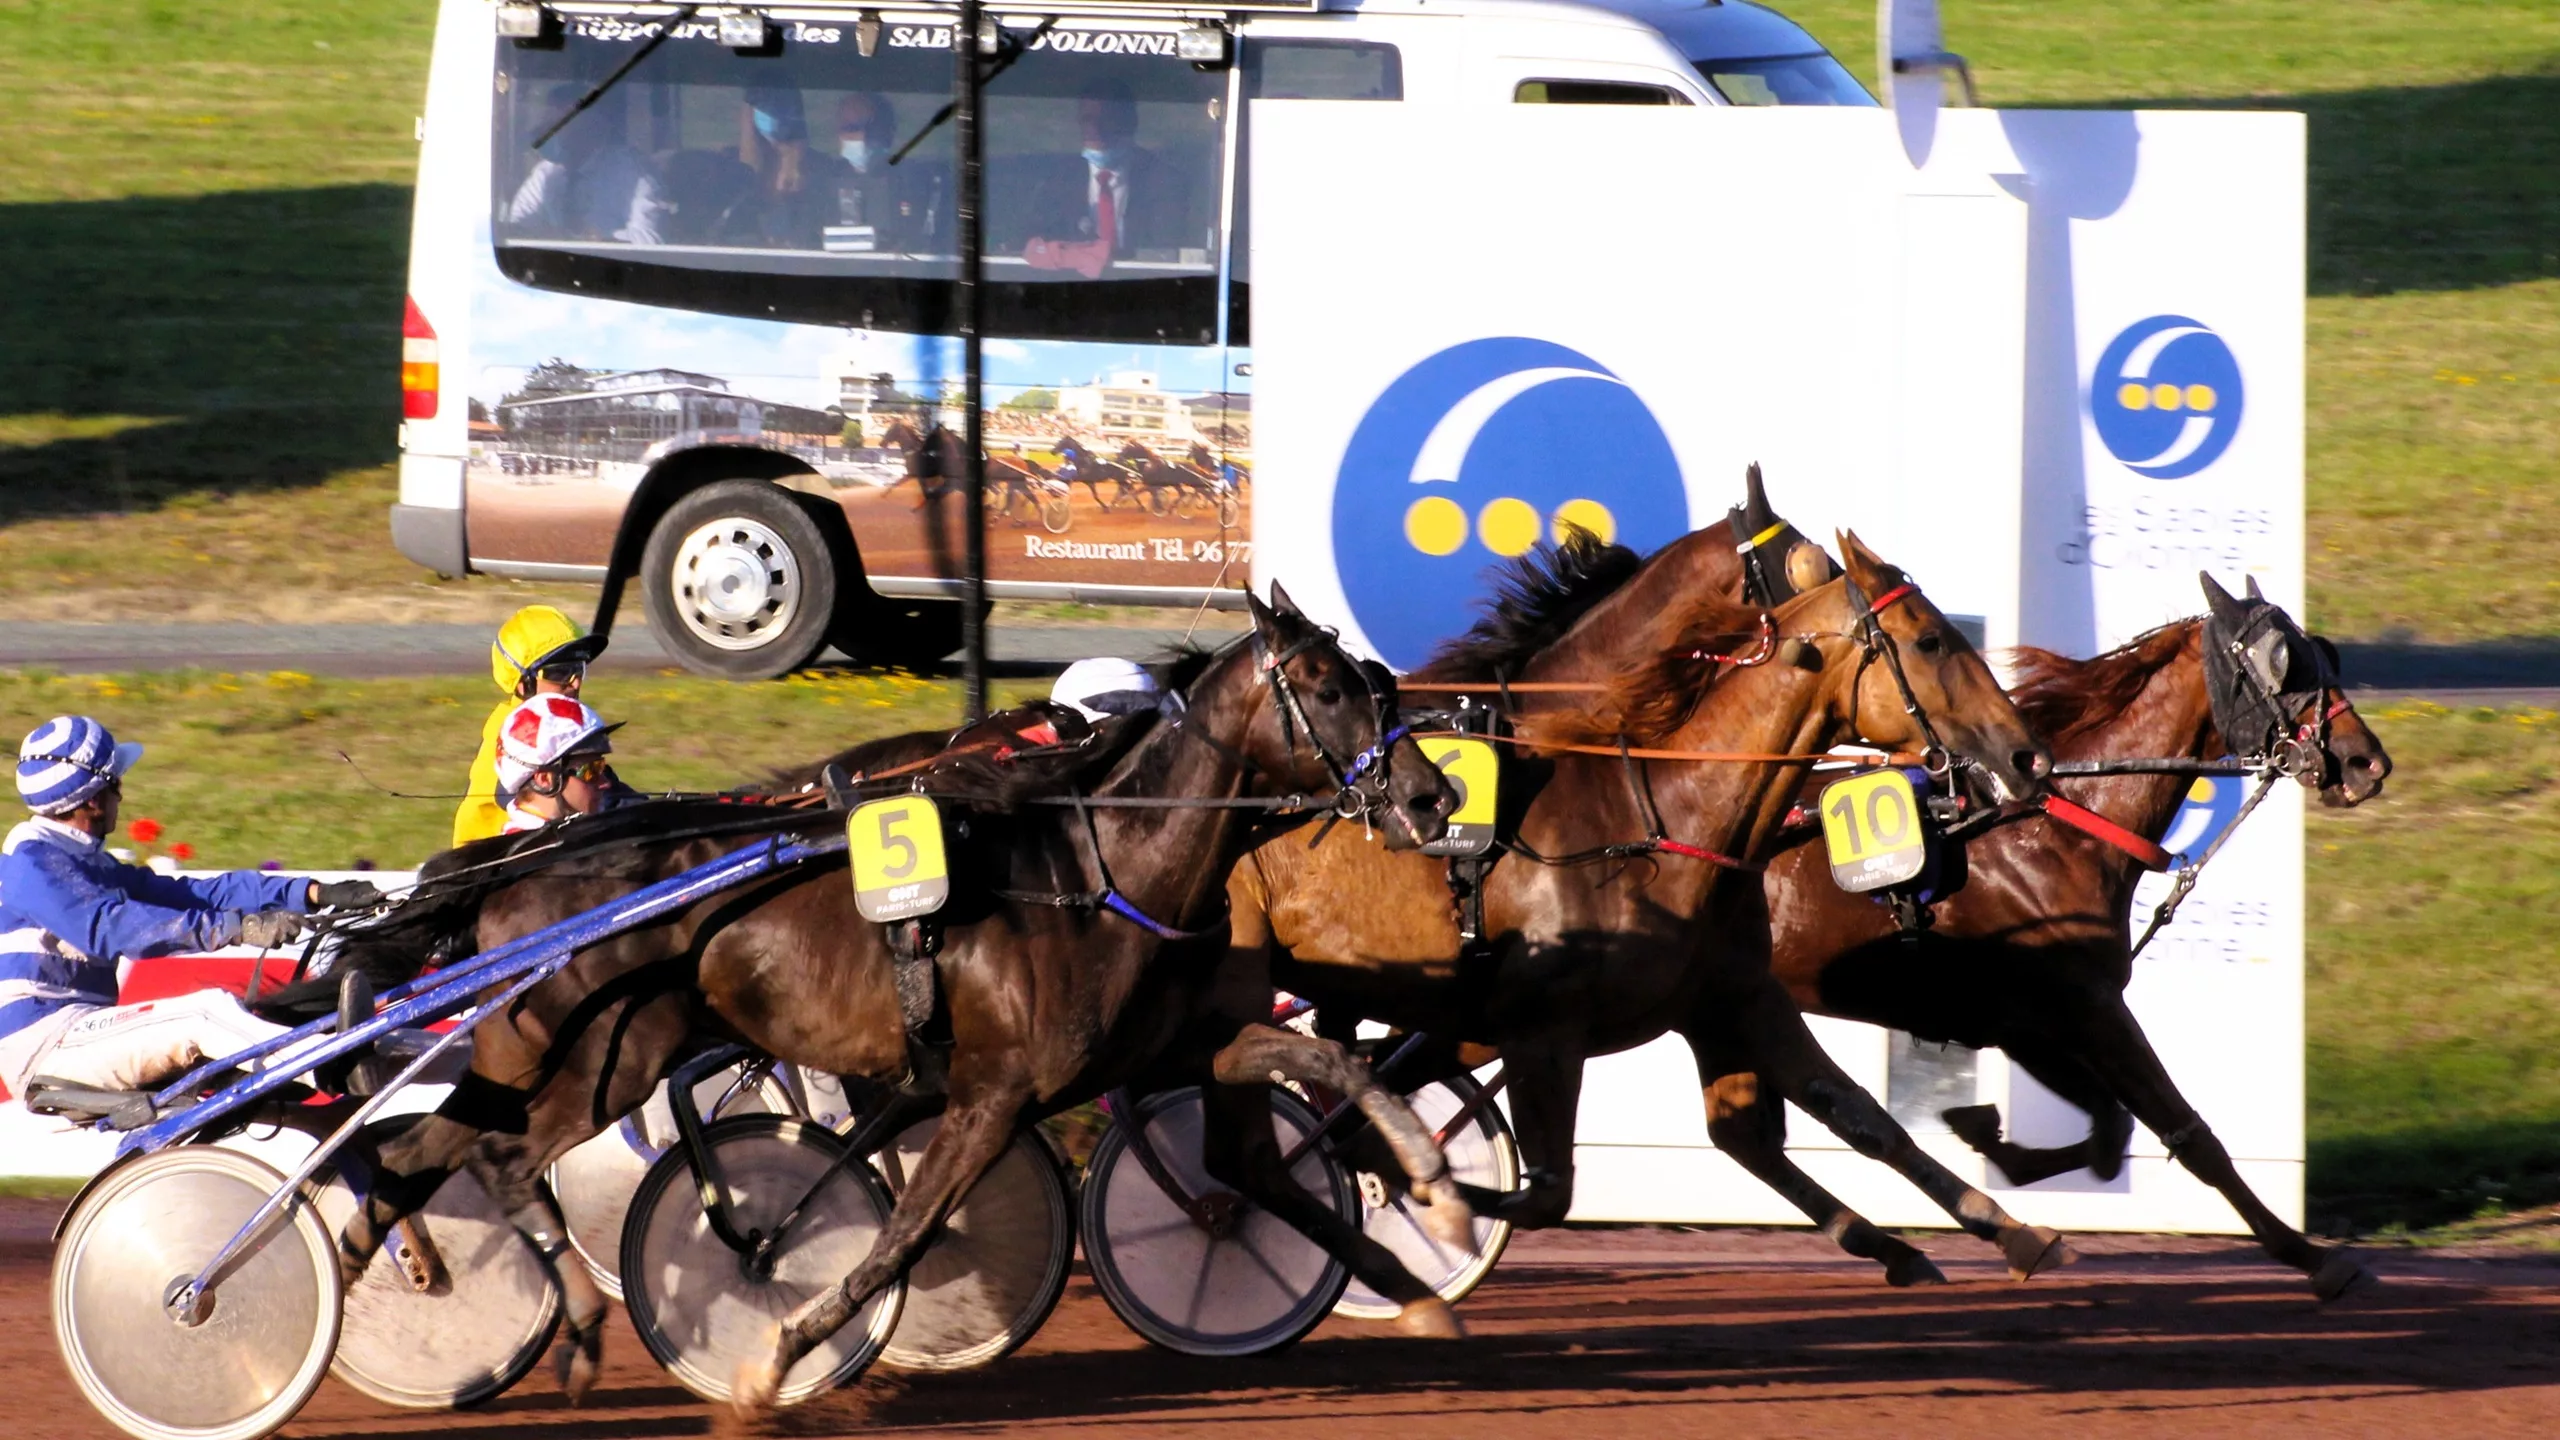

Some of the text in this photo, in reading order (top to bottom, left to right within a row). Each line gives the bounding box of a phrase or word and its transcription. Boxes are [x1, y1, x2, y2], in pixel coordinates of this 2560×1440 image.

[561, 16, 718, 41] Hippodro
[781, 22, 842, 43] des
[2133, 494, 2273, 534] Sabes
[1024, 534, 1146, 561] Restaurant
[1148, 537, 1190, 562] Tél.
[1830, 784, 1909, 855] 10
[878, 809, 917, 878] 5
[1426, 838, 1476, 849] IS-TURF
